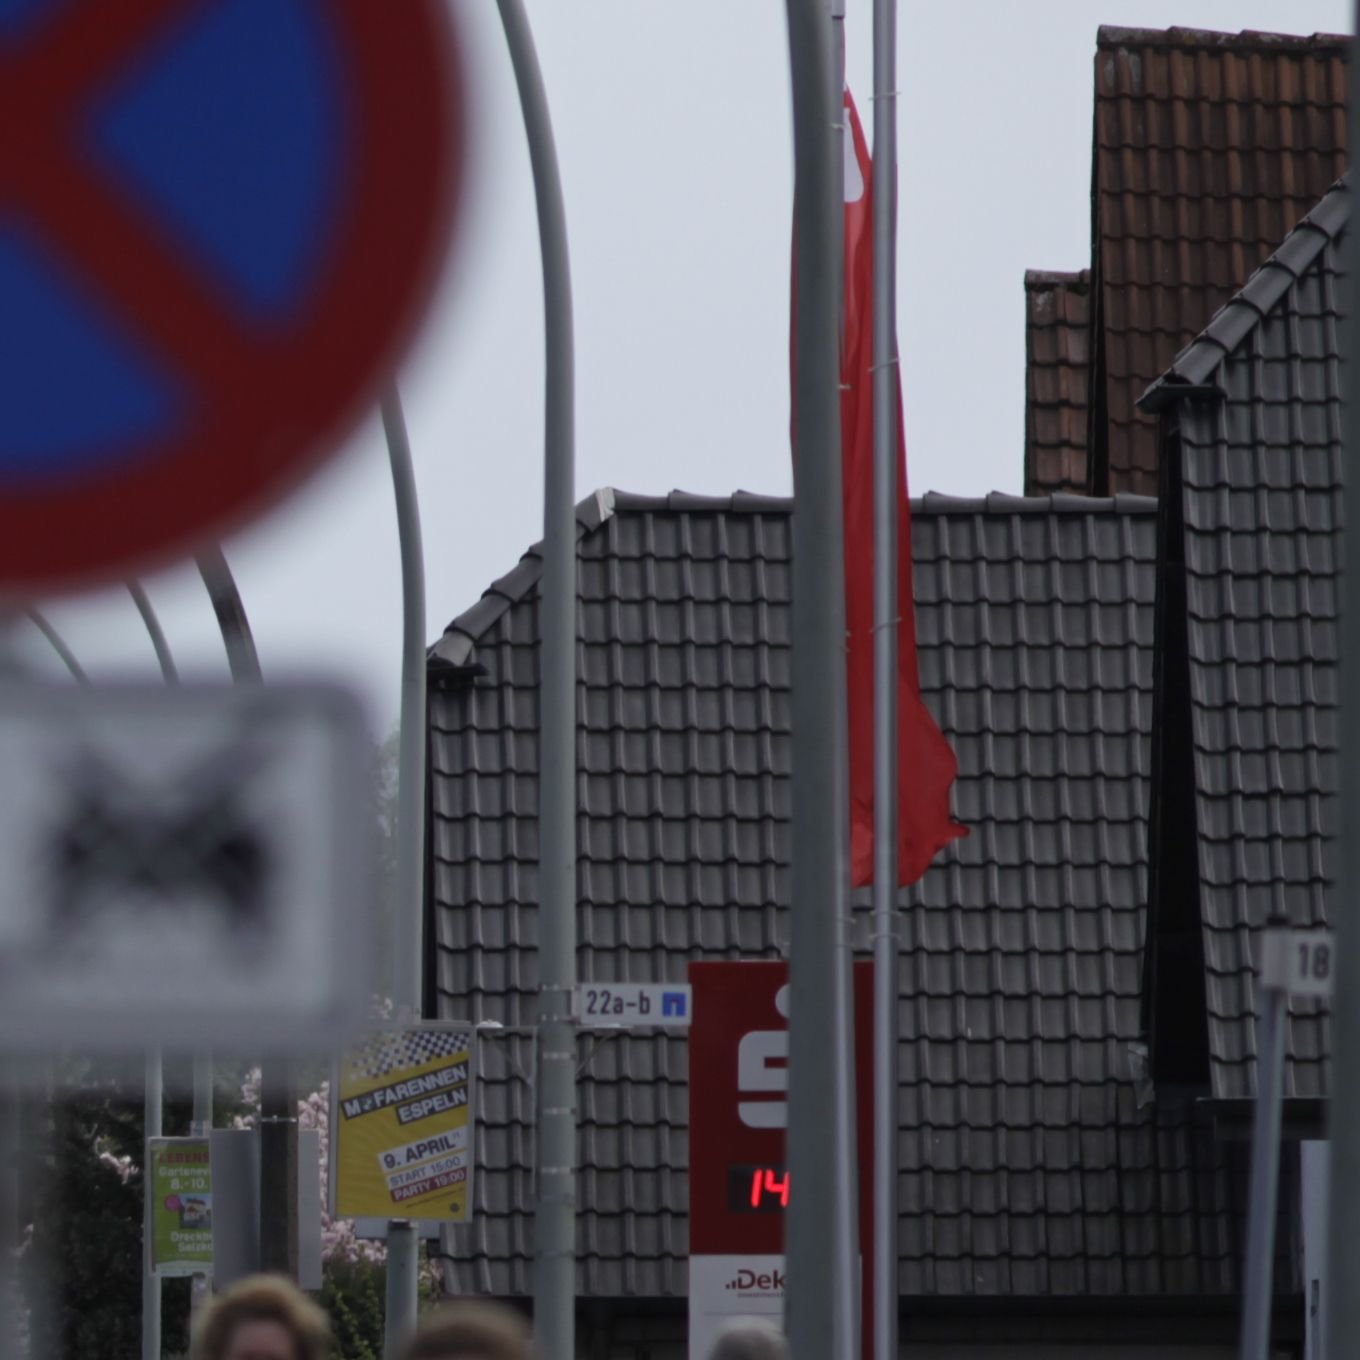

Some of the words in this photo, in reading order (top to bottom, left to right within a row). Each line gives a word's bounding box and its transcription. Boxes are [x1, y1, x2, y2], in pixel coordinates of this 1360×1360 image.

[1298, 943, 1329, 979] 18
[586, 989, 651, 1015] 22a-b
[399, 1088, 467, 1122] ESPELN
[383, 1153, 401, 1169] 9.
[406, 1135, 456, 1163] APRIL
[389, 1167, 426, 1187] START
[430, 1156, 461, 1174] 15:00
[394, 1182, 430, 1201] PARTY
[434, 1170, 465, 1188] 19:00
